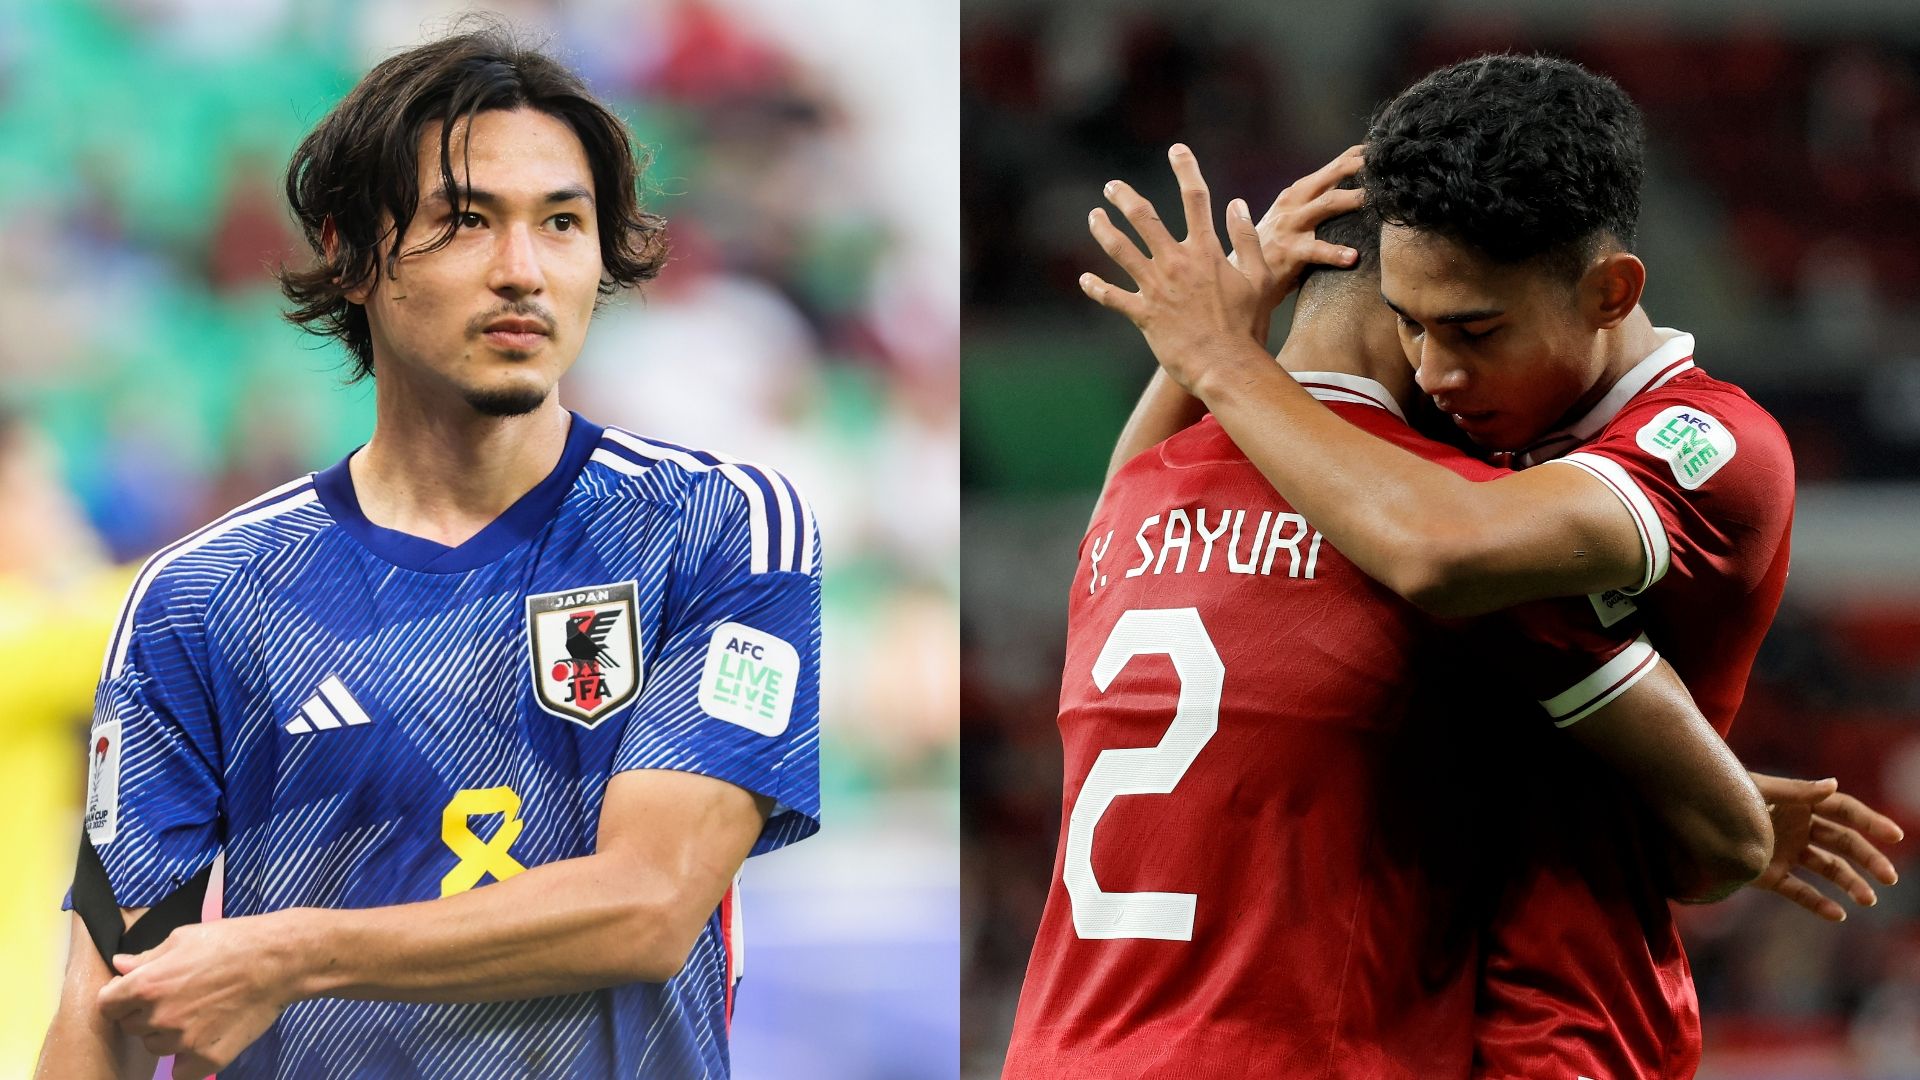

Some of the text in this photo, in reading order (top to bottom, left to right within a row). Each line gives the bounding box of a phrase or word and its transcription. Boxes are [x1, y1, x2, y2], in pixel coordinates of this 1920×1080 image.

[1677, 413, 1711, 433] AFC
[1665, 418, 1719, 464] LIVE
[1125, 508, 1323, 579] SAYURI
[555, 590, 609, 608] JAPAN
[726, 637, 764, 660] AFC
[719, 653, 782, 695] LIVE
[564, 679, 612, 702] JFA
[1063, 607, 1225, 941] 2
[95, 809, 108, 820] CUP
[441, 785, 529, 898] 8
